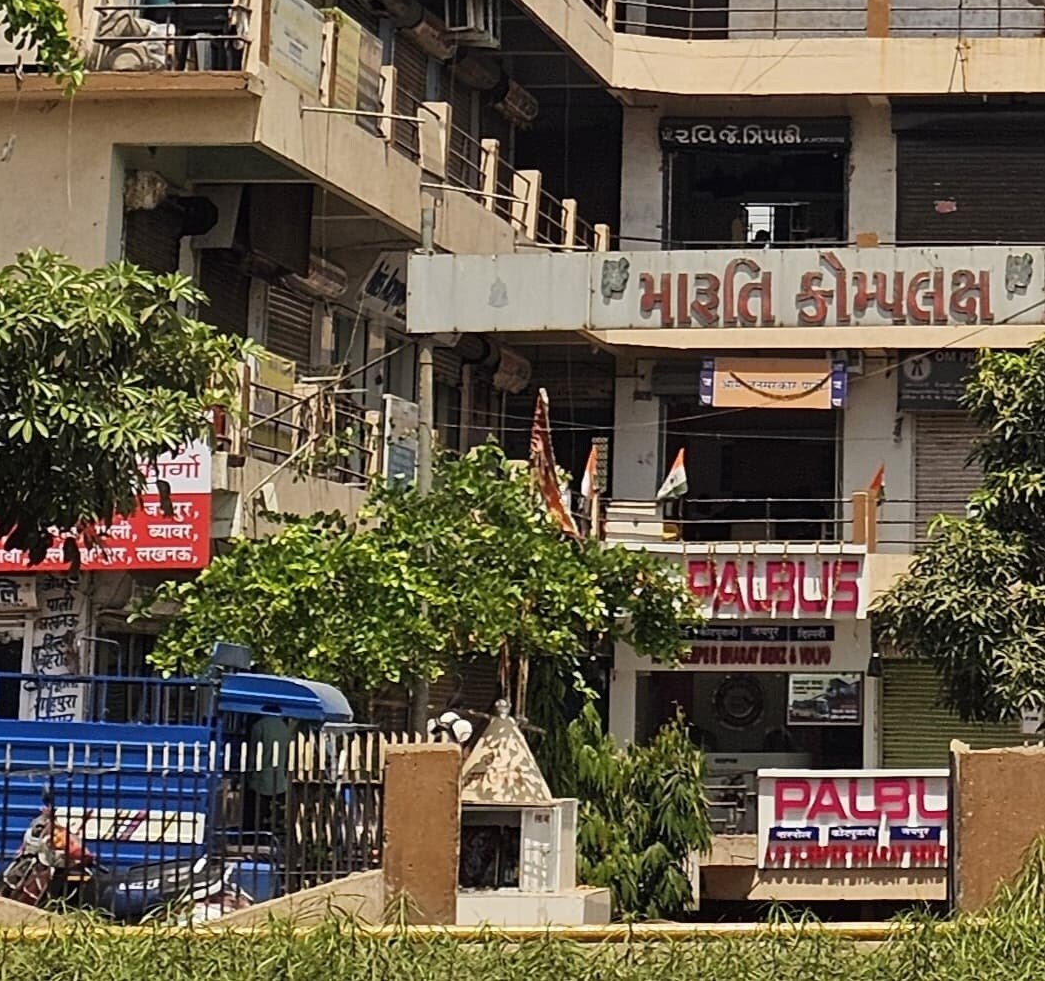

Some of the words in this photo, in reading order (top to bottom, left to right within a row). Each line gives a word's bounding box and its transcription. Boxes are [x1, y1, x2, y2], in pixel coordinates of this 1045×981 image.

[675, 124, 717, 144] રવિ
[640, 257, 774, 327] મારૂતિ
[795, 251, 995, 327] કોમ્પલક્ષ
[135, 545, 199, 564] लखनऊ,
[687, 560, 860, 613] PALBUS
